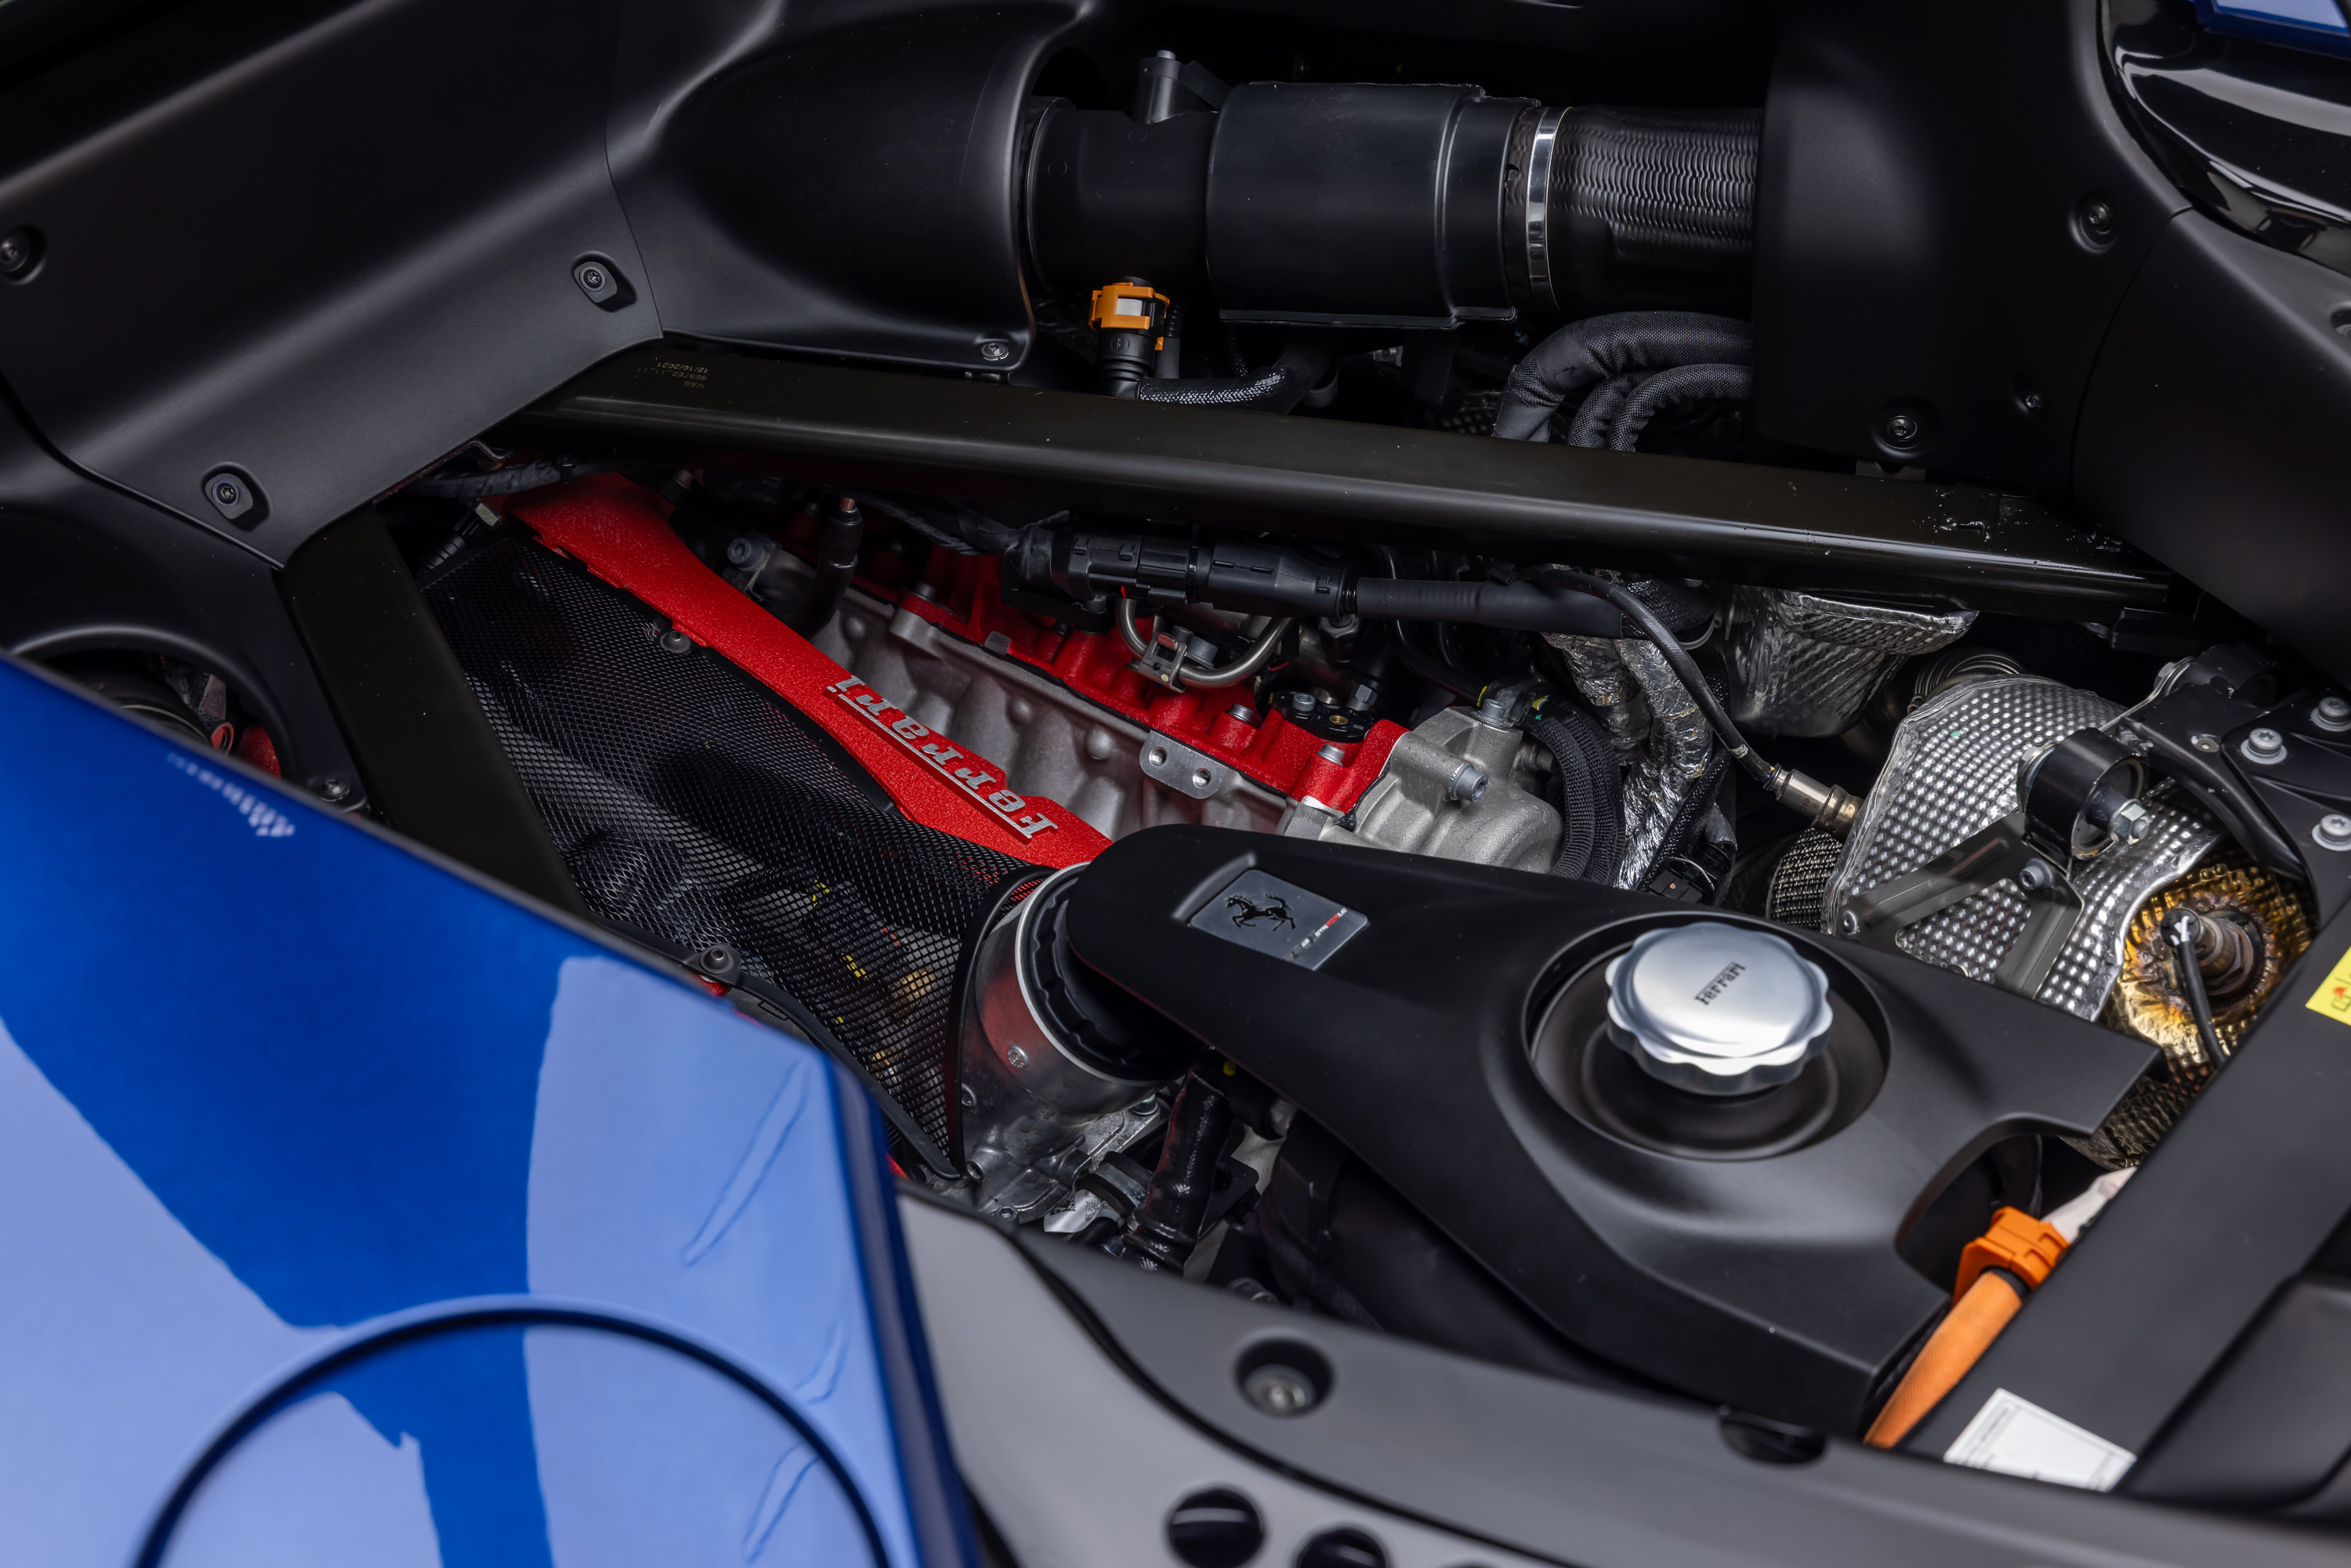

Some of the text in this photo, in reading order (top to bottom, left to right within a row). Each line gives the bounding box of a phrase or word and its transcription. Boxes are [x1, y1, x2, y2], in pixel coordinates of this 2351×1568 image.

[657, 361, 708, 374] 12/10/2021
[827, 675, 1059, 839] Ferrari
[1694, 961, 1746, 1005] Ferrari
